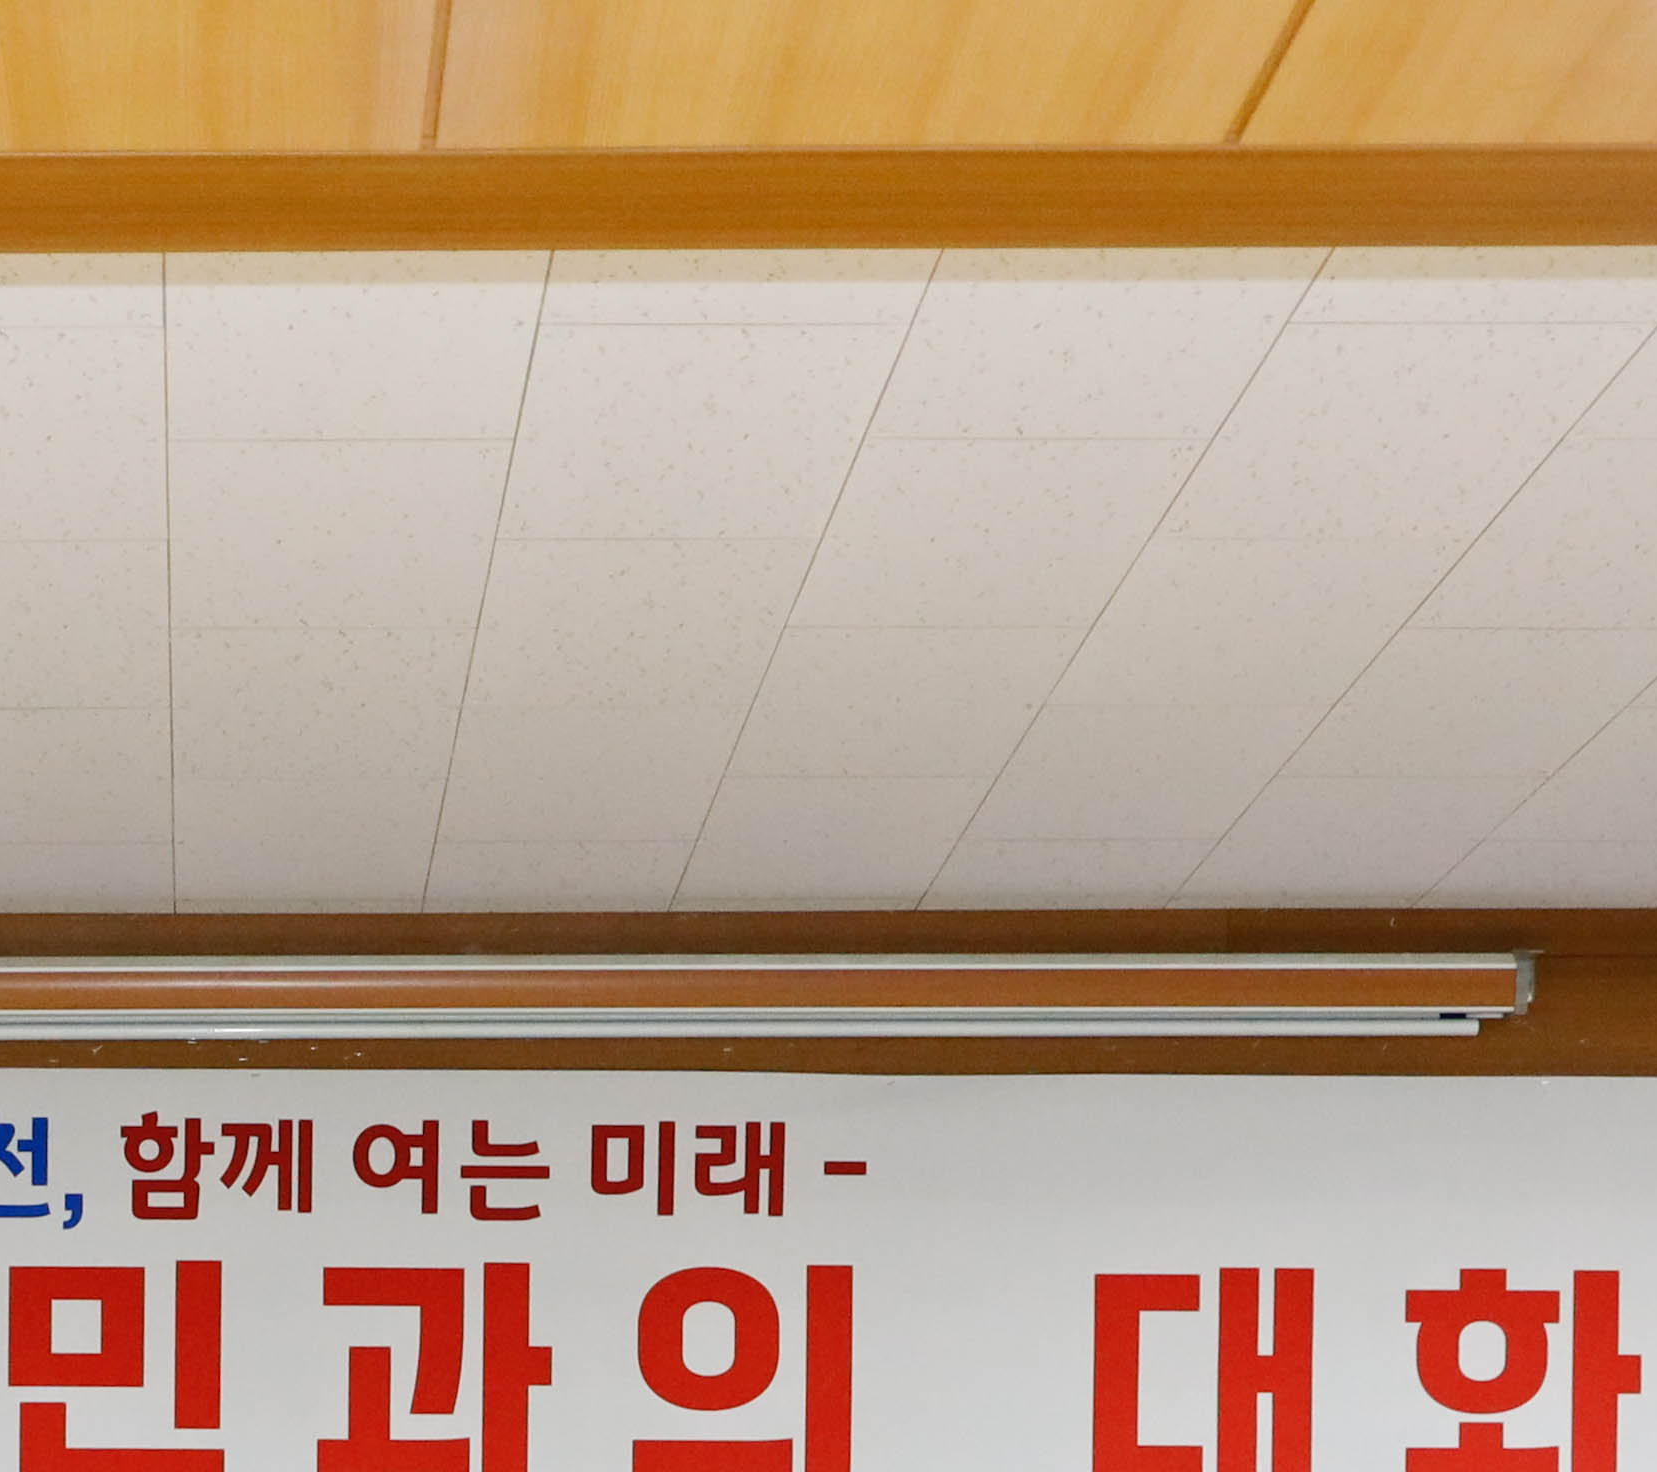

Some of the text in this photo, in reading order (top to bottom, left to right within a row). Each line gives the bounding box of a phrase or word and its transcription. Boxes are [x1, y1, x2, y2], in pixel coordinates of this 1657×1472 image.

[121, 1111, 314, 1220] 함께
[354, 1119, 552, 1222] 여는
[591, 1121, 787, 1217] 미래
